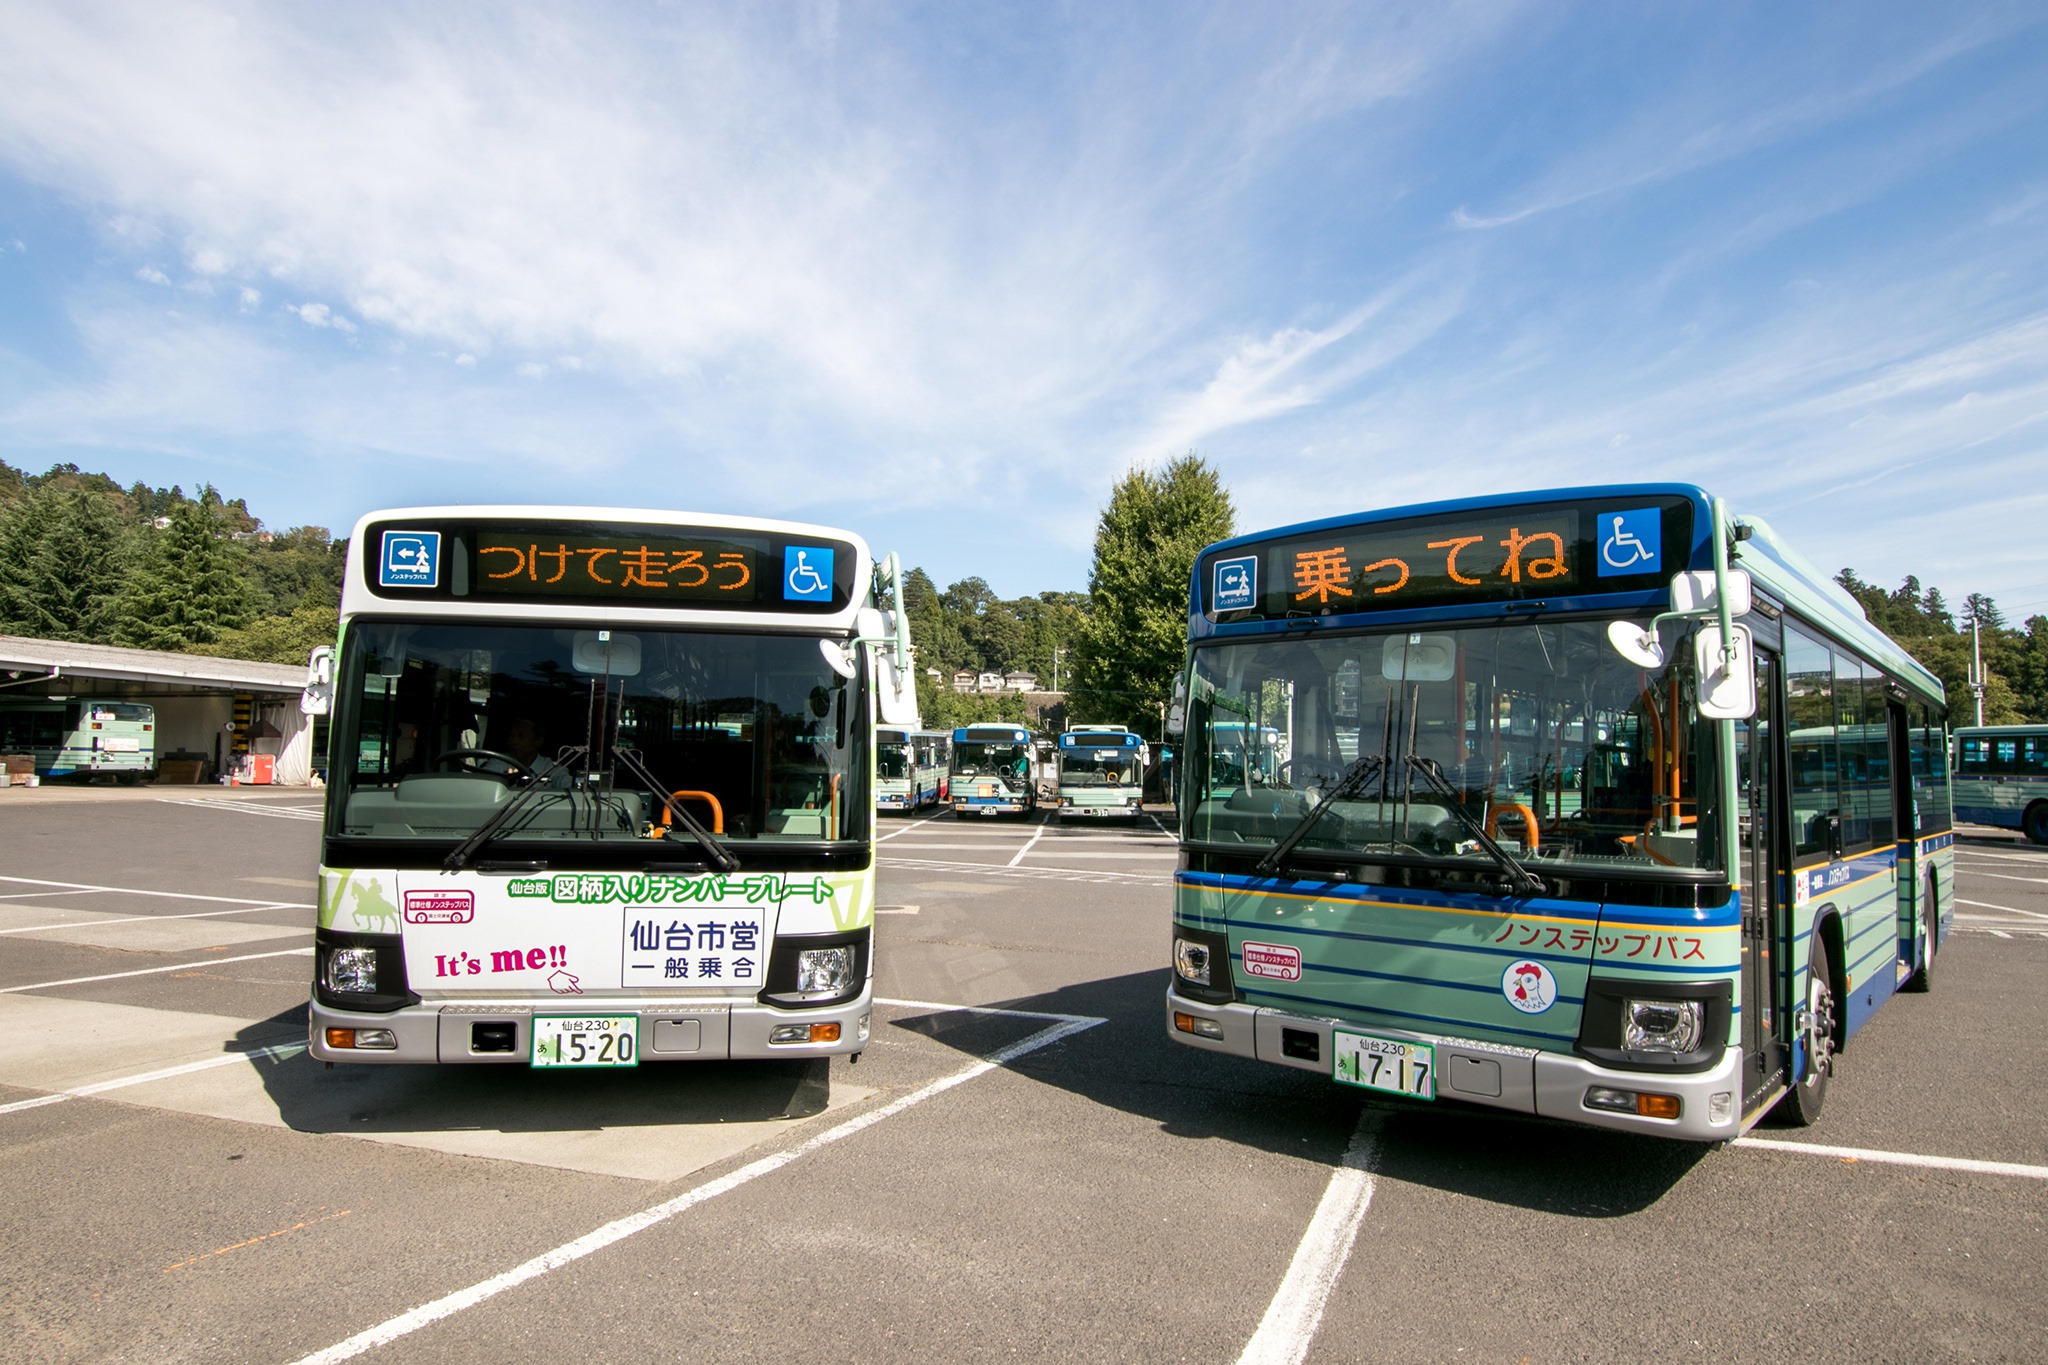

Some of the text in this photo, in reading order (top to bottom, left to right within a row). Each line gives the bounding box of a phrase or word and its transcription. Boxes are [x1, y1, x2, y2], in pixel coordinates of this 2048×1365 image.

[479, 544, 750, 590] つけて走ろう
[1293, 527, 1569, 603] 乗ってね
[554, 876, 833, 902] 図柄入りナンバープレート
[629, 919, 759, 952] 仙台市営
[1495, 923, 1706, 961] ノンステップバス
[490, 944, 568, 973] me!!
[630, 955, 756, 979] 一般乗合
[537, 1032, 634, 1063] あ 15-20
[1338, 1050, 1429, 1093] あ 17-17
